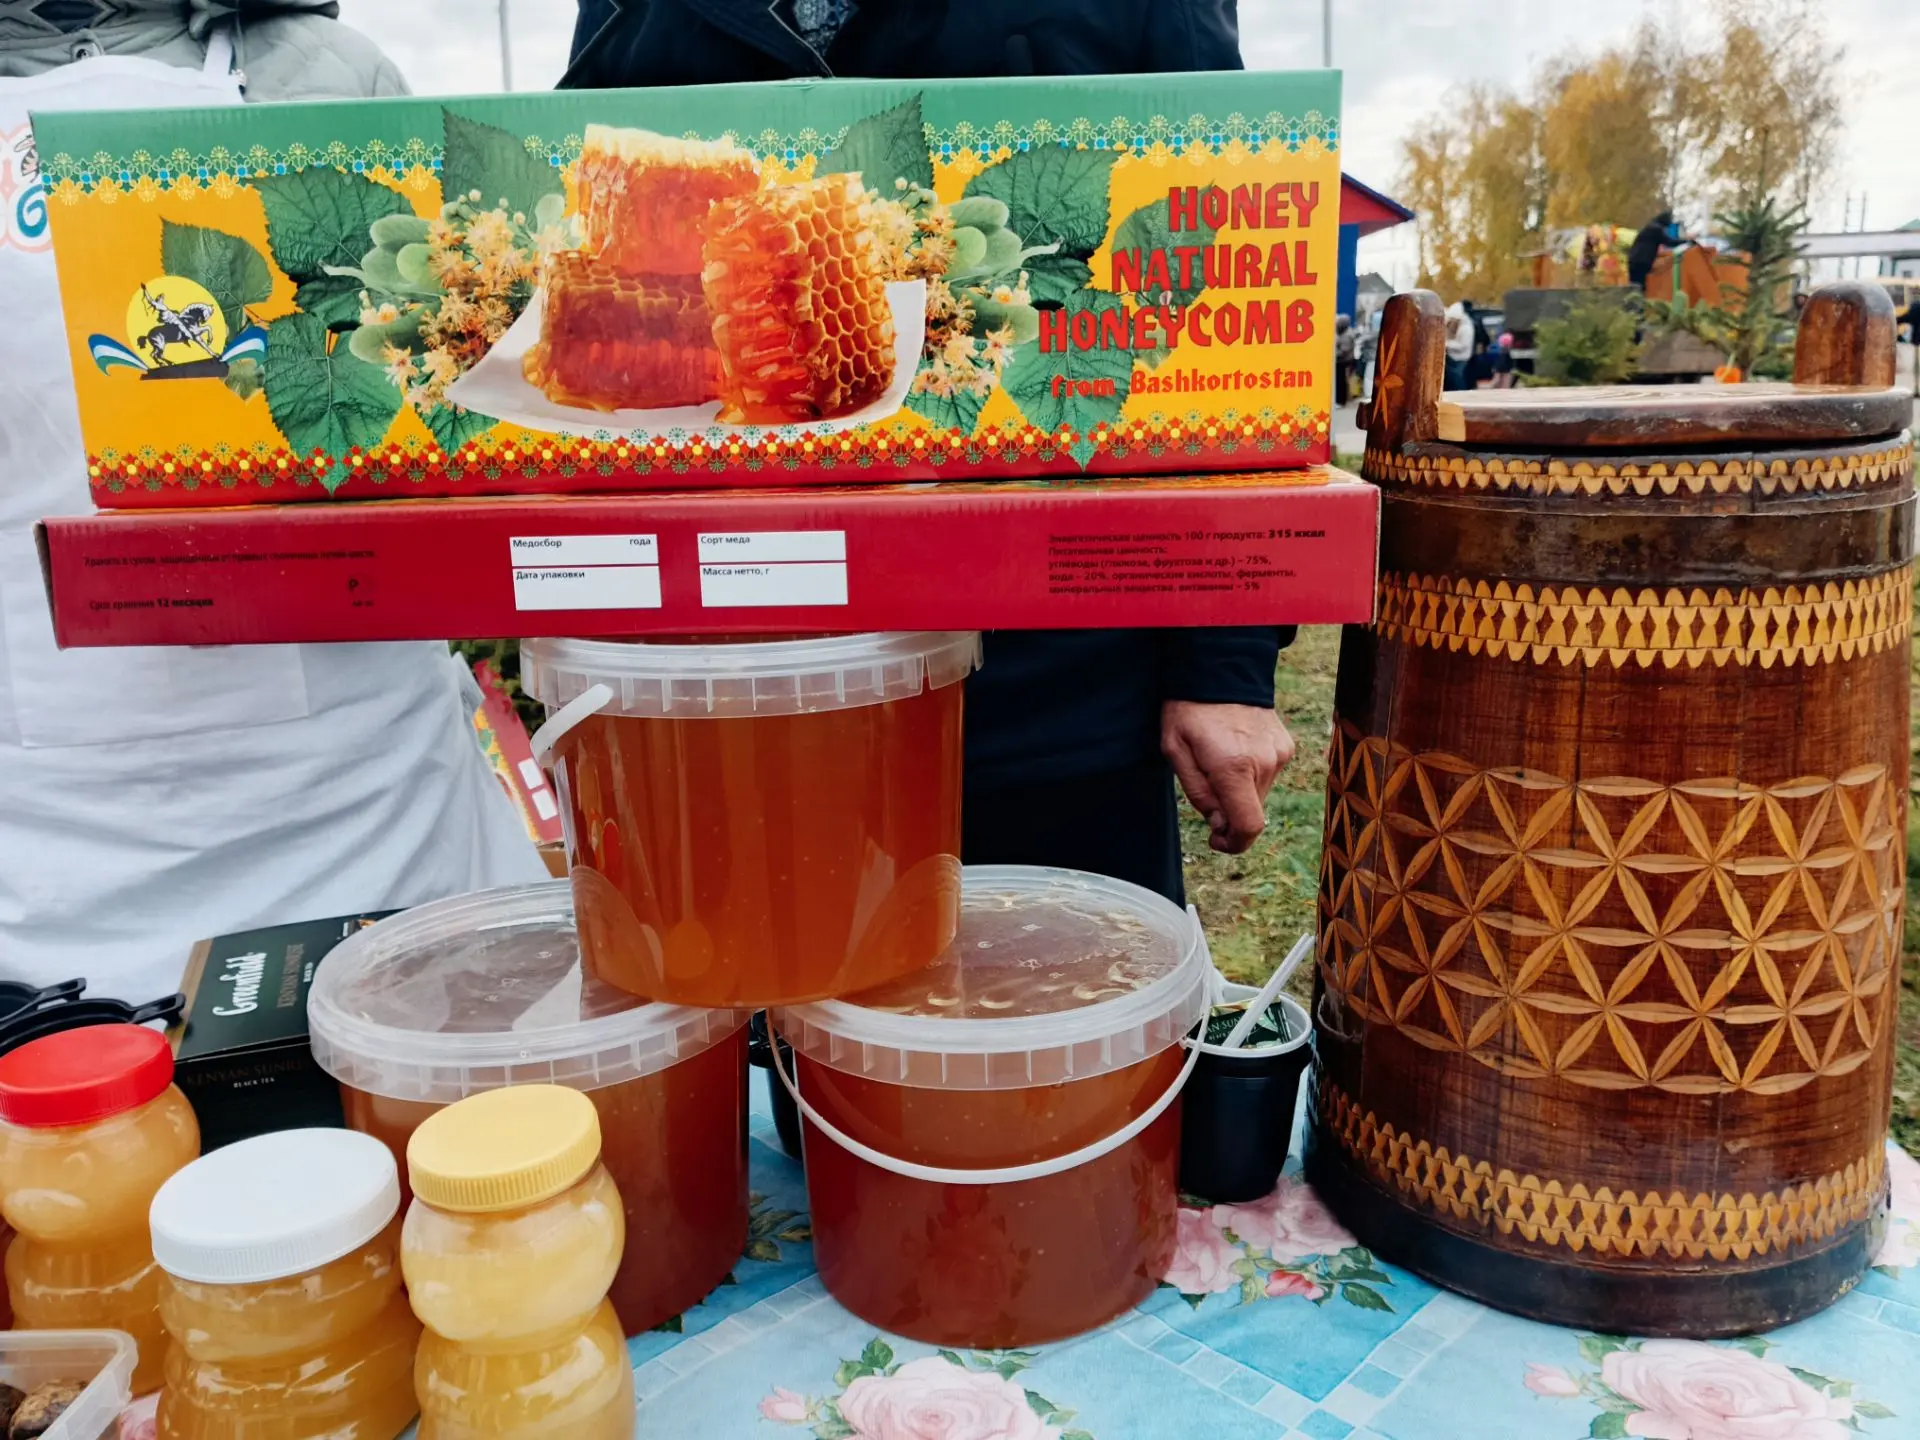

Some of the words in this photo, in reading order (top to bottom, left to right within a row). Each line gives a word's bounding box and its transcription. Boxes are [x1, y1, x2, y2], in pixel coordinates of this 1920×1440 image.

[1168, 182, 1319, 232] HONEY
[1111, 240, 1318, 292] NATURAL
[1038, 299, 1314, 353] HONEYCOMB
[1050, 373, 1116, 399] from
[1130, 368, 1313, 395] Bashkortostan
[1184, 531, 1204, 540] 100
[1268, 529, 1292, 539] 315
[512, 538, 563, 549] Медосбор
[629, 538, 651, 547] года
[700, 535, 723, 546] Сорт
[725, 536, 751, 545] меда
[515, 570, 538, 580] Дата
[540, 571, 586, 581] упаковки
[702, 567, 732, 576] Масса
[734, 567, 763, 577] нетто,
[156, 598, 170, 608] 12
[212, 951, 268, 1016] Greenfield
